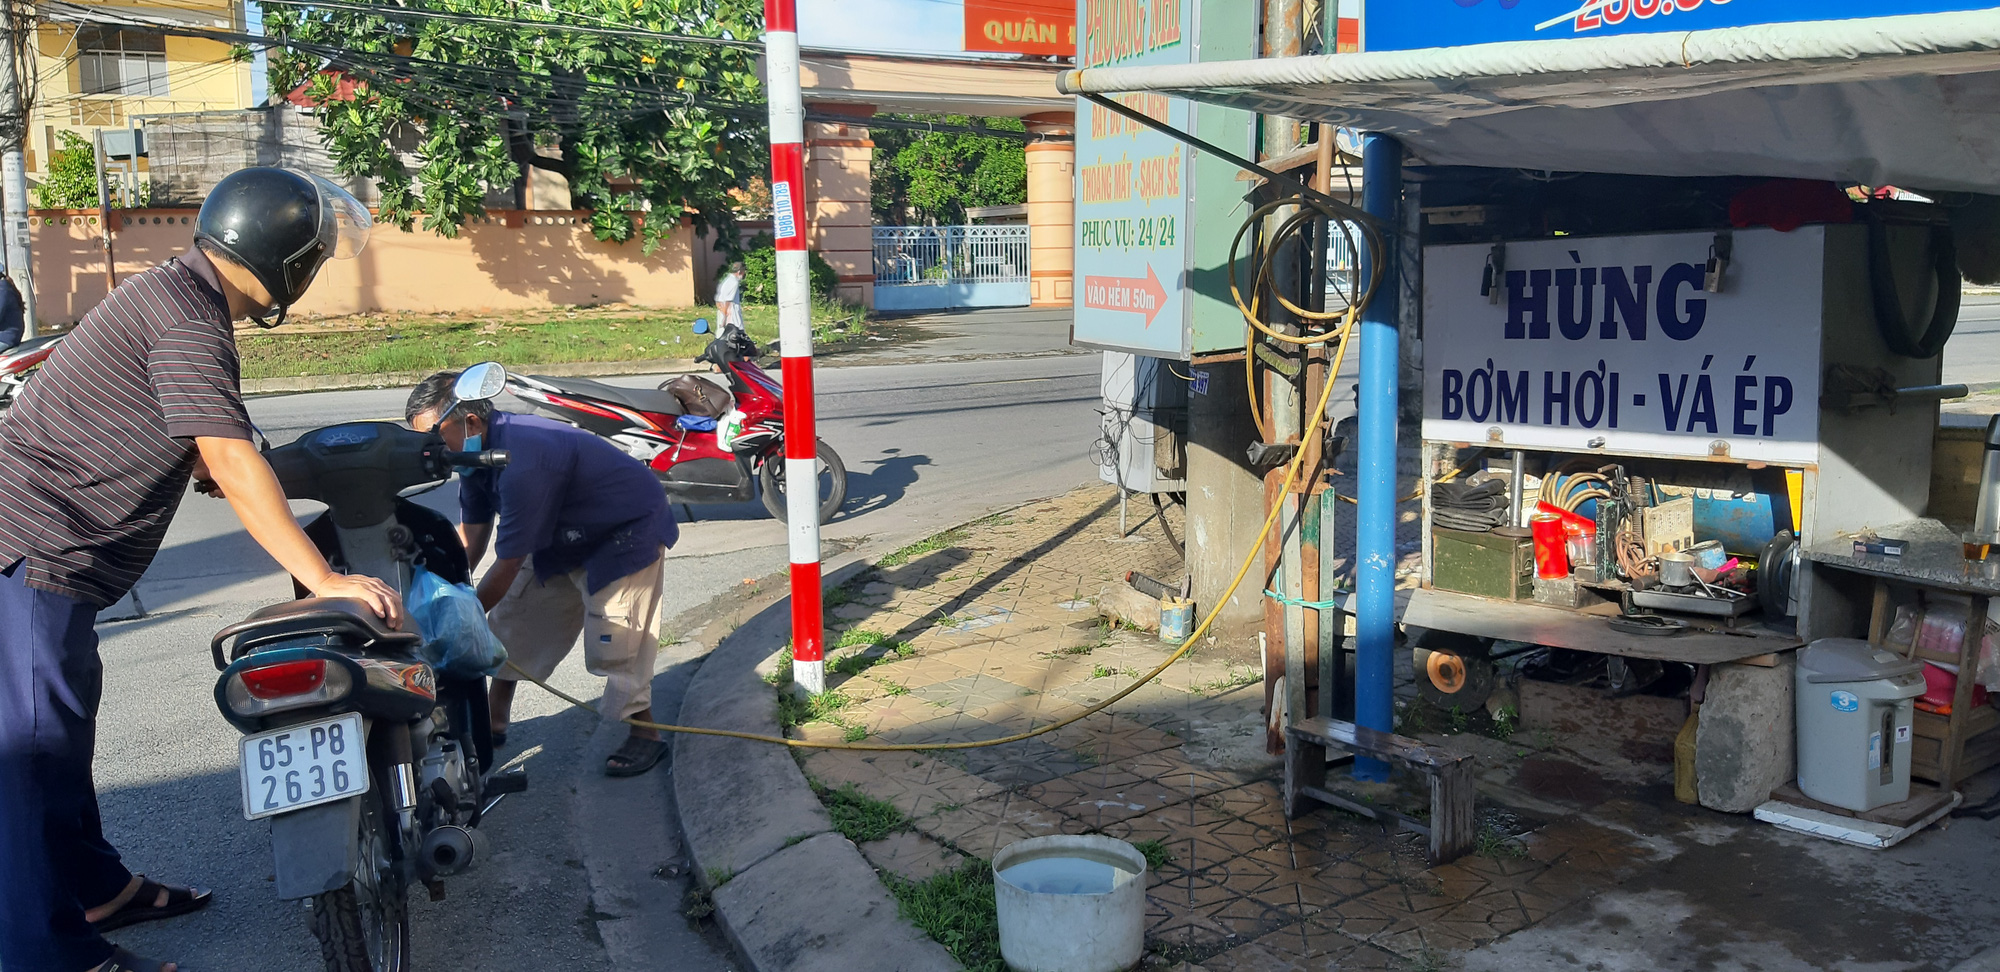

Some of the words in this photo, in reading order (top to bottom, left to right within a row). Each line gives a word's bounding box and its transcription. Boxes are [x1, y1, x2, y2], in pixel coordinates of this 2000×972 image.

[984, 17, 1057, 44] QUÂN
[1081, 155, 1112, 204] THOÁNG
[1114, 150, 1132, 202] MÁT
[1140, 156, 1164, 207] SẠCH
[1082, 219, 1111, 252] PHỤC
[1115, 219, 1134, 252] VỤ:
[1088, 281, 1106, 305] VÀO
[1108, 280, 1130, 307] HẺM
[1133, 288, 1155, 309] 50m
[1504, 250, 1707, 341] HÙNG
[1442, 357, 1529, 424] BƠM
[1543, 359, 1619, 428] HƠI
[1658, 354, 1718, 434] VÁ
[1733, 355, 1793, 437] ÉP
[258, 723, 345, 771] 65-P8
[261, 760, 349, 810] 2636
